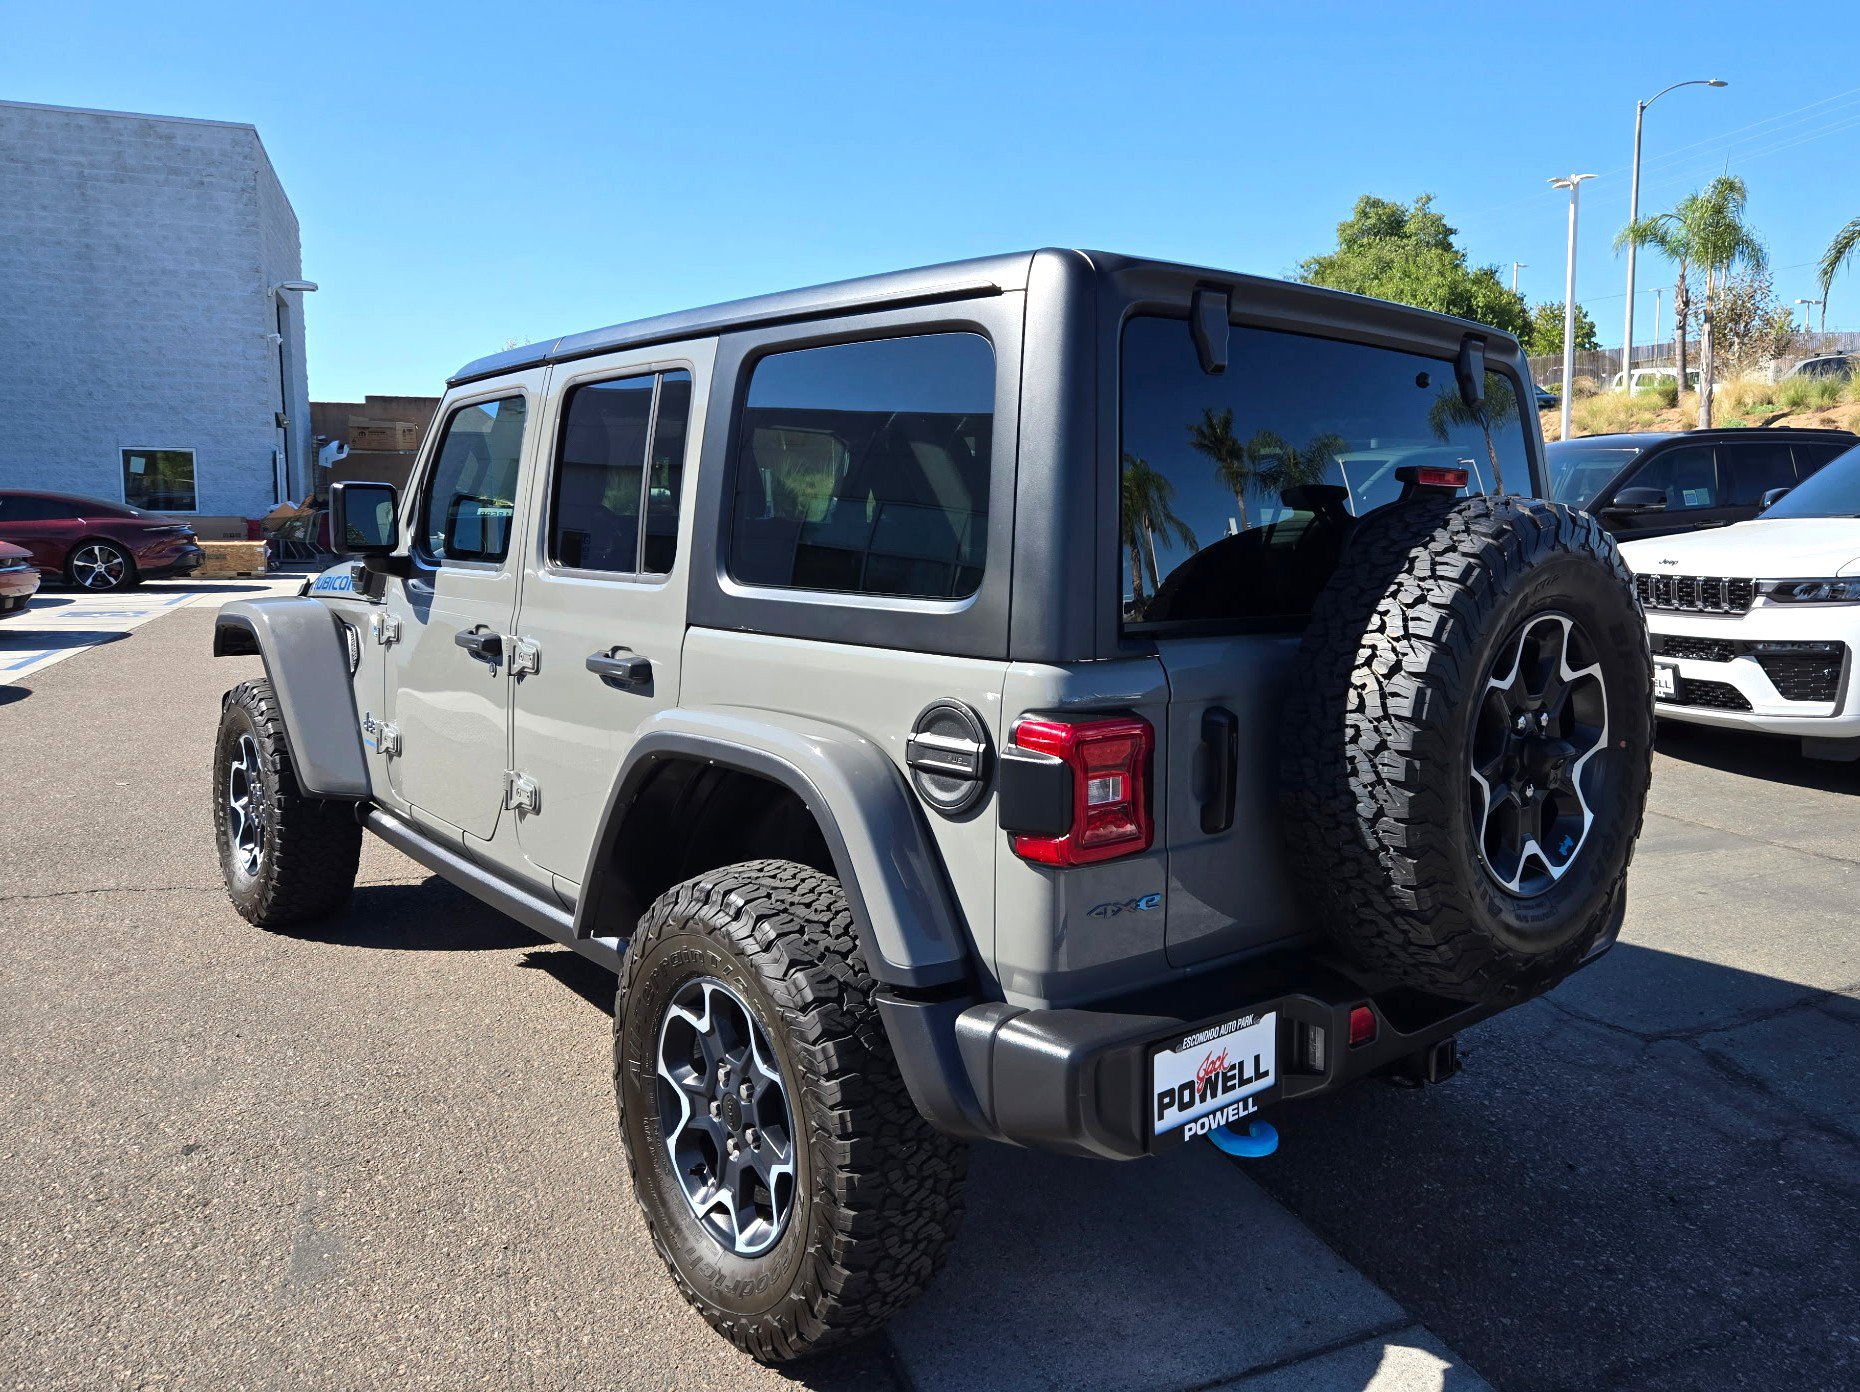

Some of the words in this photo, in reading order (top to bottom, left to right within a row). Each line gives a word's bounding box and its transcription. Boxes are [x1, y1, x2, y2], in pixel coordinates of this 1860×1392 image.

[1182, 1026, 1220, 1050] ESCONDIDO
[1219, 1020, 1237, 1037] AUTO
[1237, 1014, 1254, 1030] PARK
[1157, 1053, 1270, 1122] POWELL
[1196, 1046, 1231, 1095] Jack
[1184, 1097, 1258, 1142] POWELL
